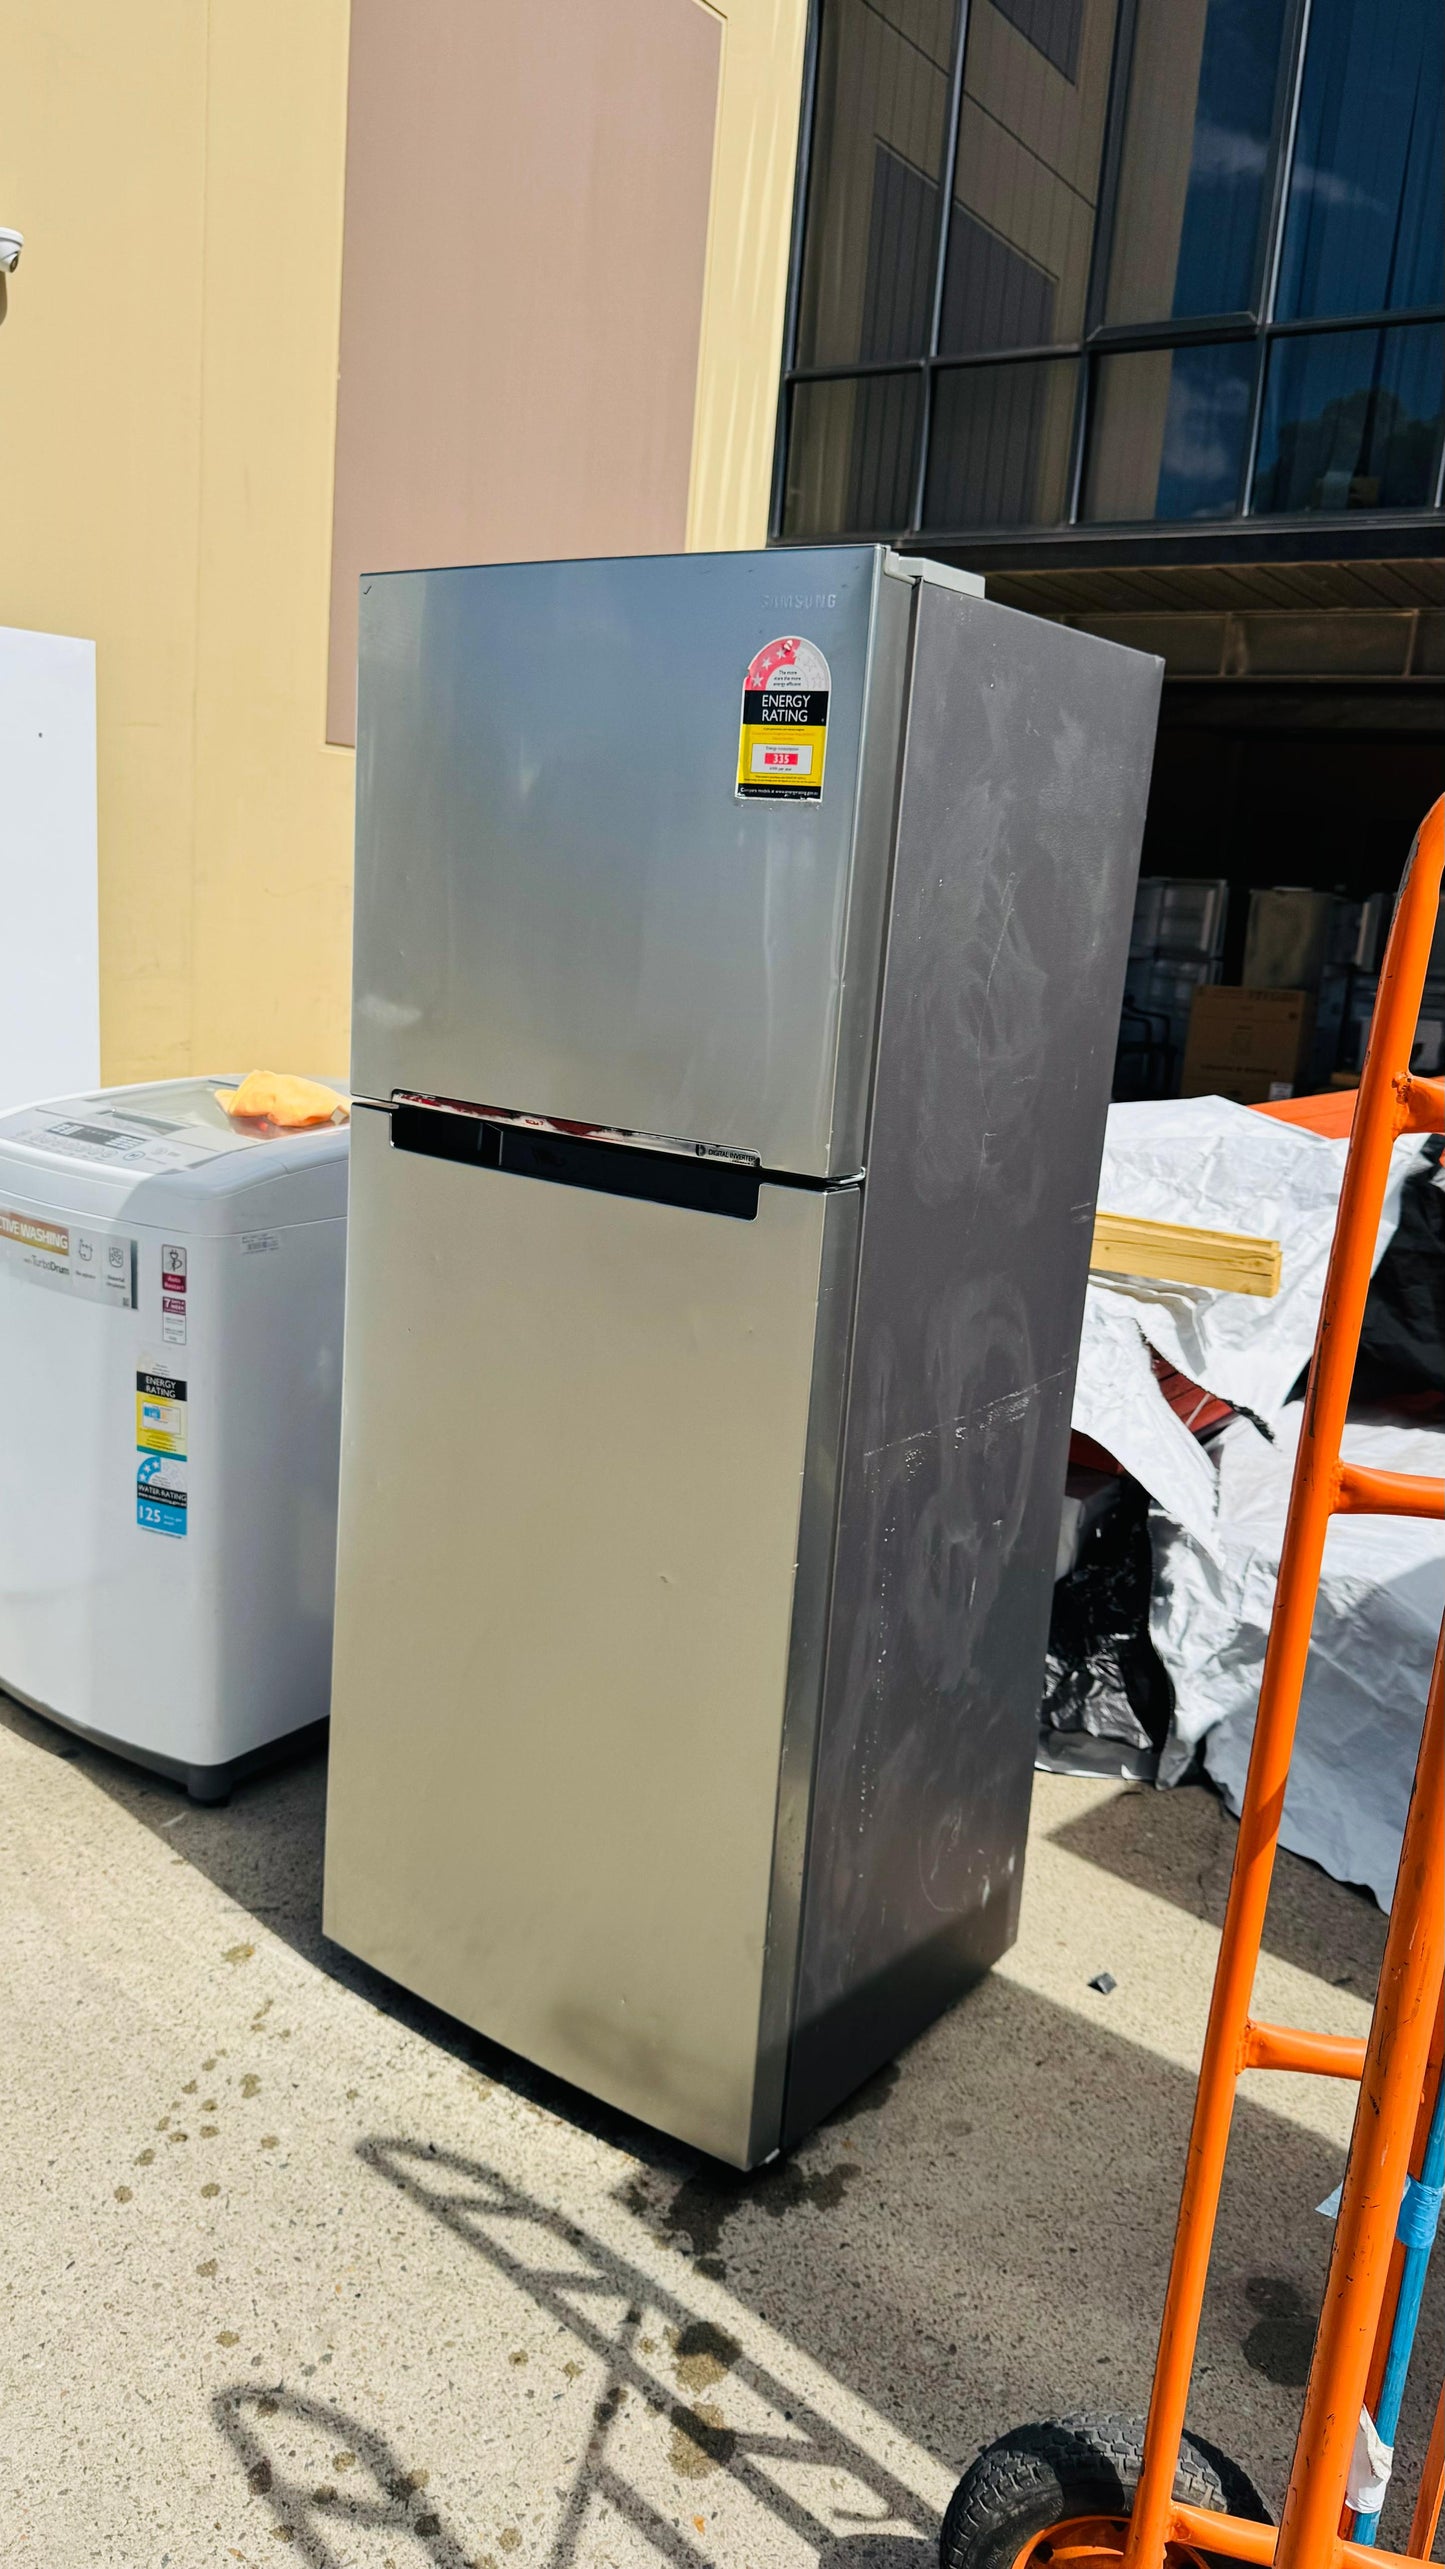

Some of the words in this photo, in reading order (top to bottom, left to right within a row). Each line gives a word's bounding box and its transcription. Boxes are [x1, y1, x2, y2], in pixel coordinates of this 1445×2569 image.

[760, 594, 837, 609] SAMSUNG
[761, 694, 812, 708] ENERGY
[761, 709, 809, 722] RATING
[772, 753, 790, 764] 335
[708, 1149, 729, 1158] DIGITAL
[0, 1215, 20, 1235] TIVE
[20, 1222, 69, 1249] WASHING
[145, 1375, 176, 1389] ENERGY
[145, 1385, 176, 1399] RATING
[138, 1483, 160, 1496] WATER
[160, 1487, 187, 1502] RATING
[139, 1504, 161, 1523] 125
